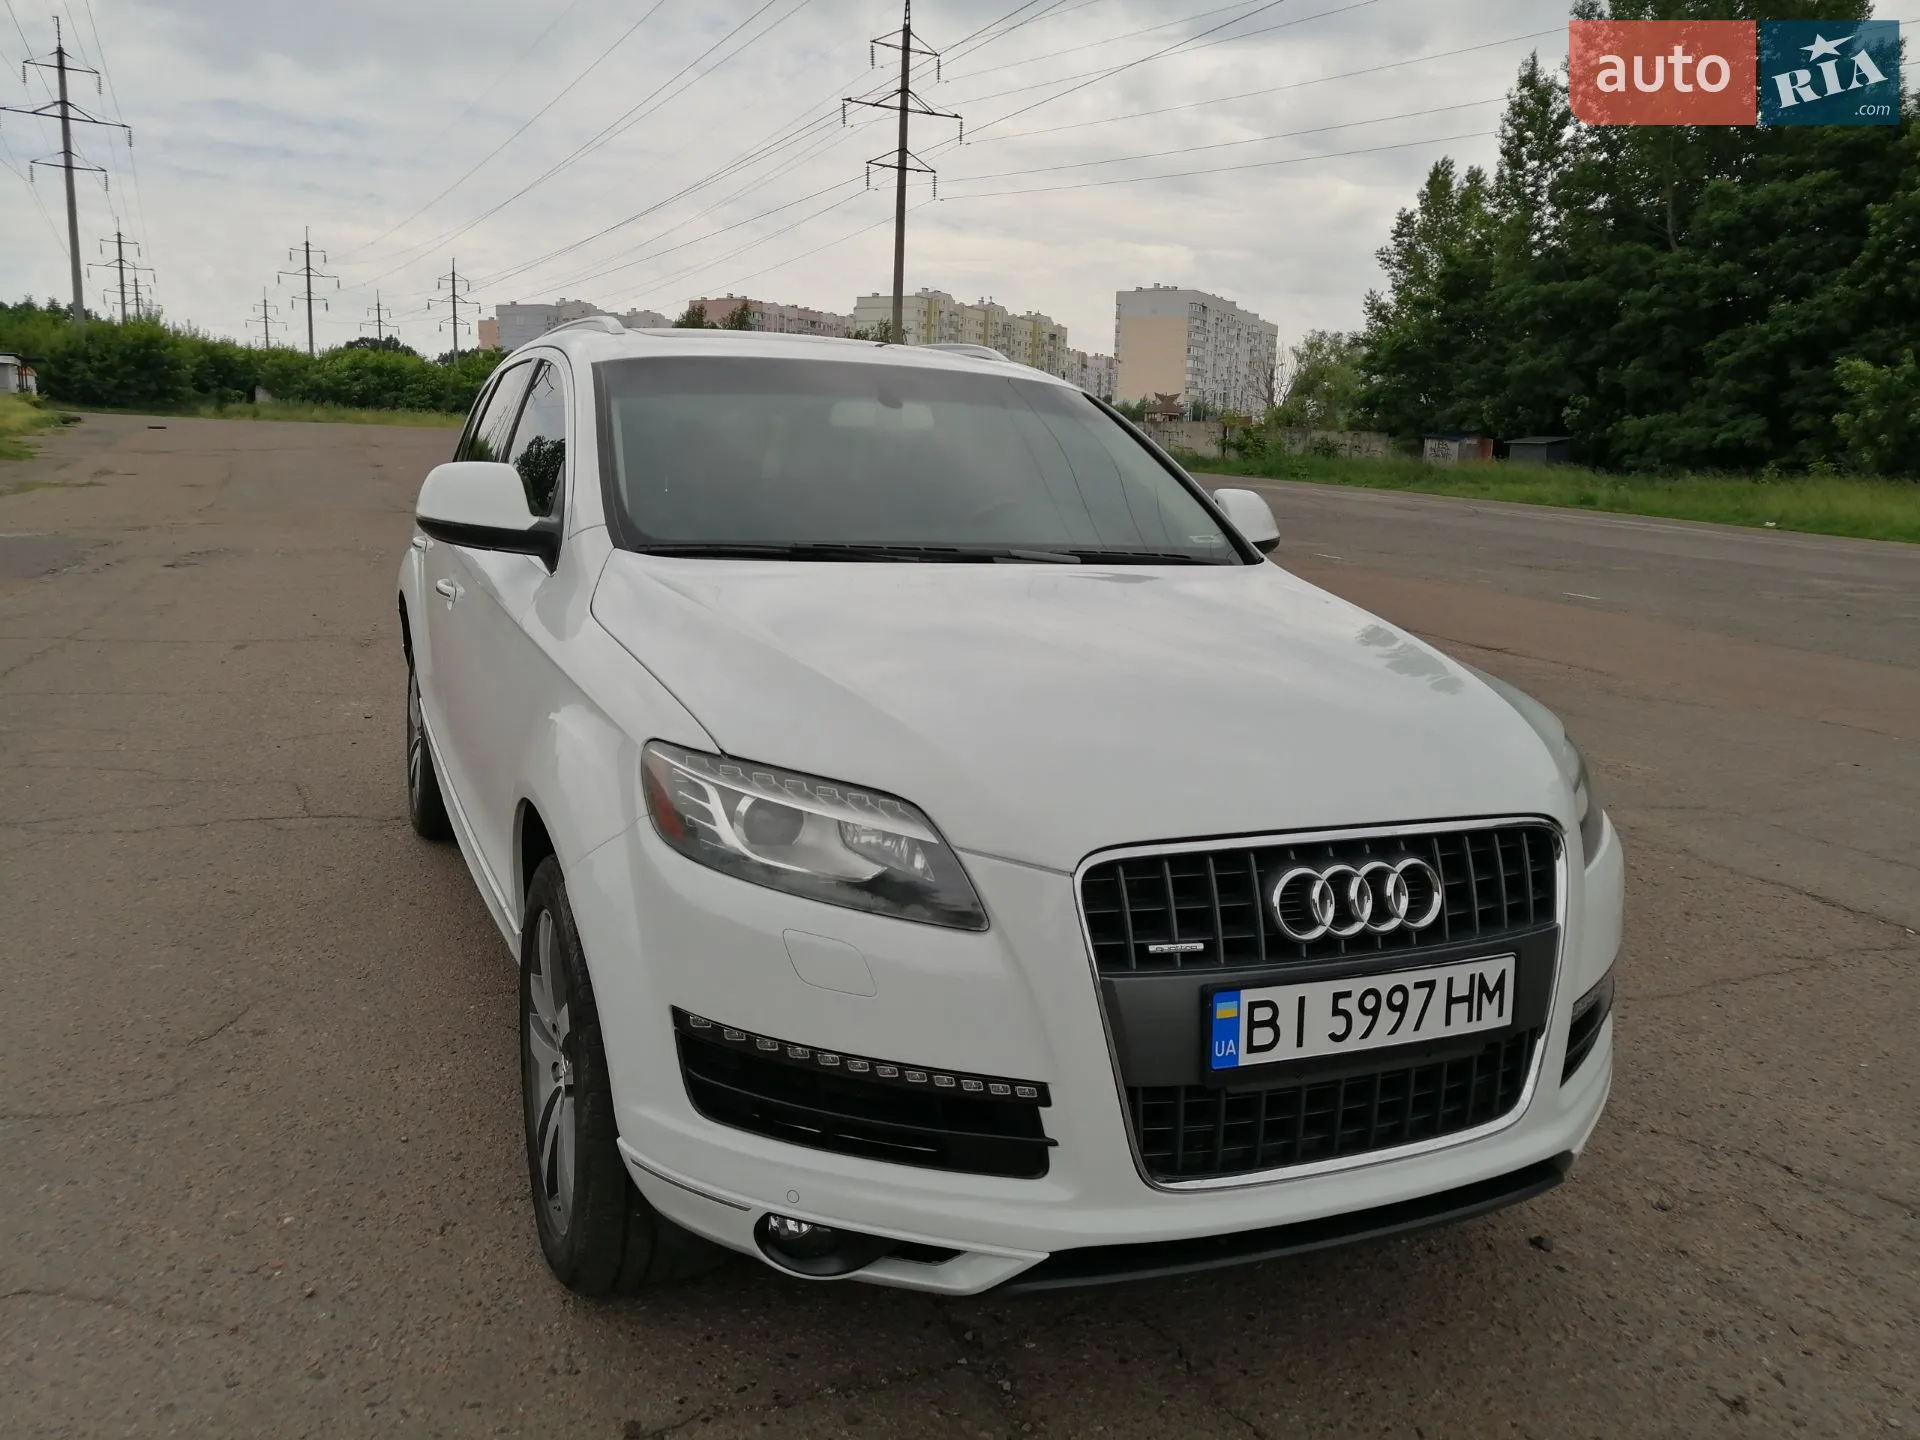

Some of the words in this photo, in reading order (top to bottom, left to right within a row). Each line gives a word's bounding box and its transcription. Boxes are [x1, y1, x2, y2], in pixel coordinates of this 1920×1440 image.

[1246, 995, 1306, 1055] BI
[1327, 979, 1437, 1043] 5997
[1444, 968, 1507, 1027] HM
[1214, 1040, 1237, 1057] UA
